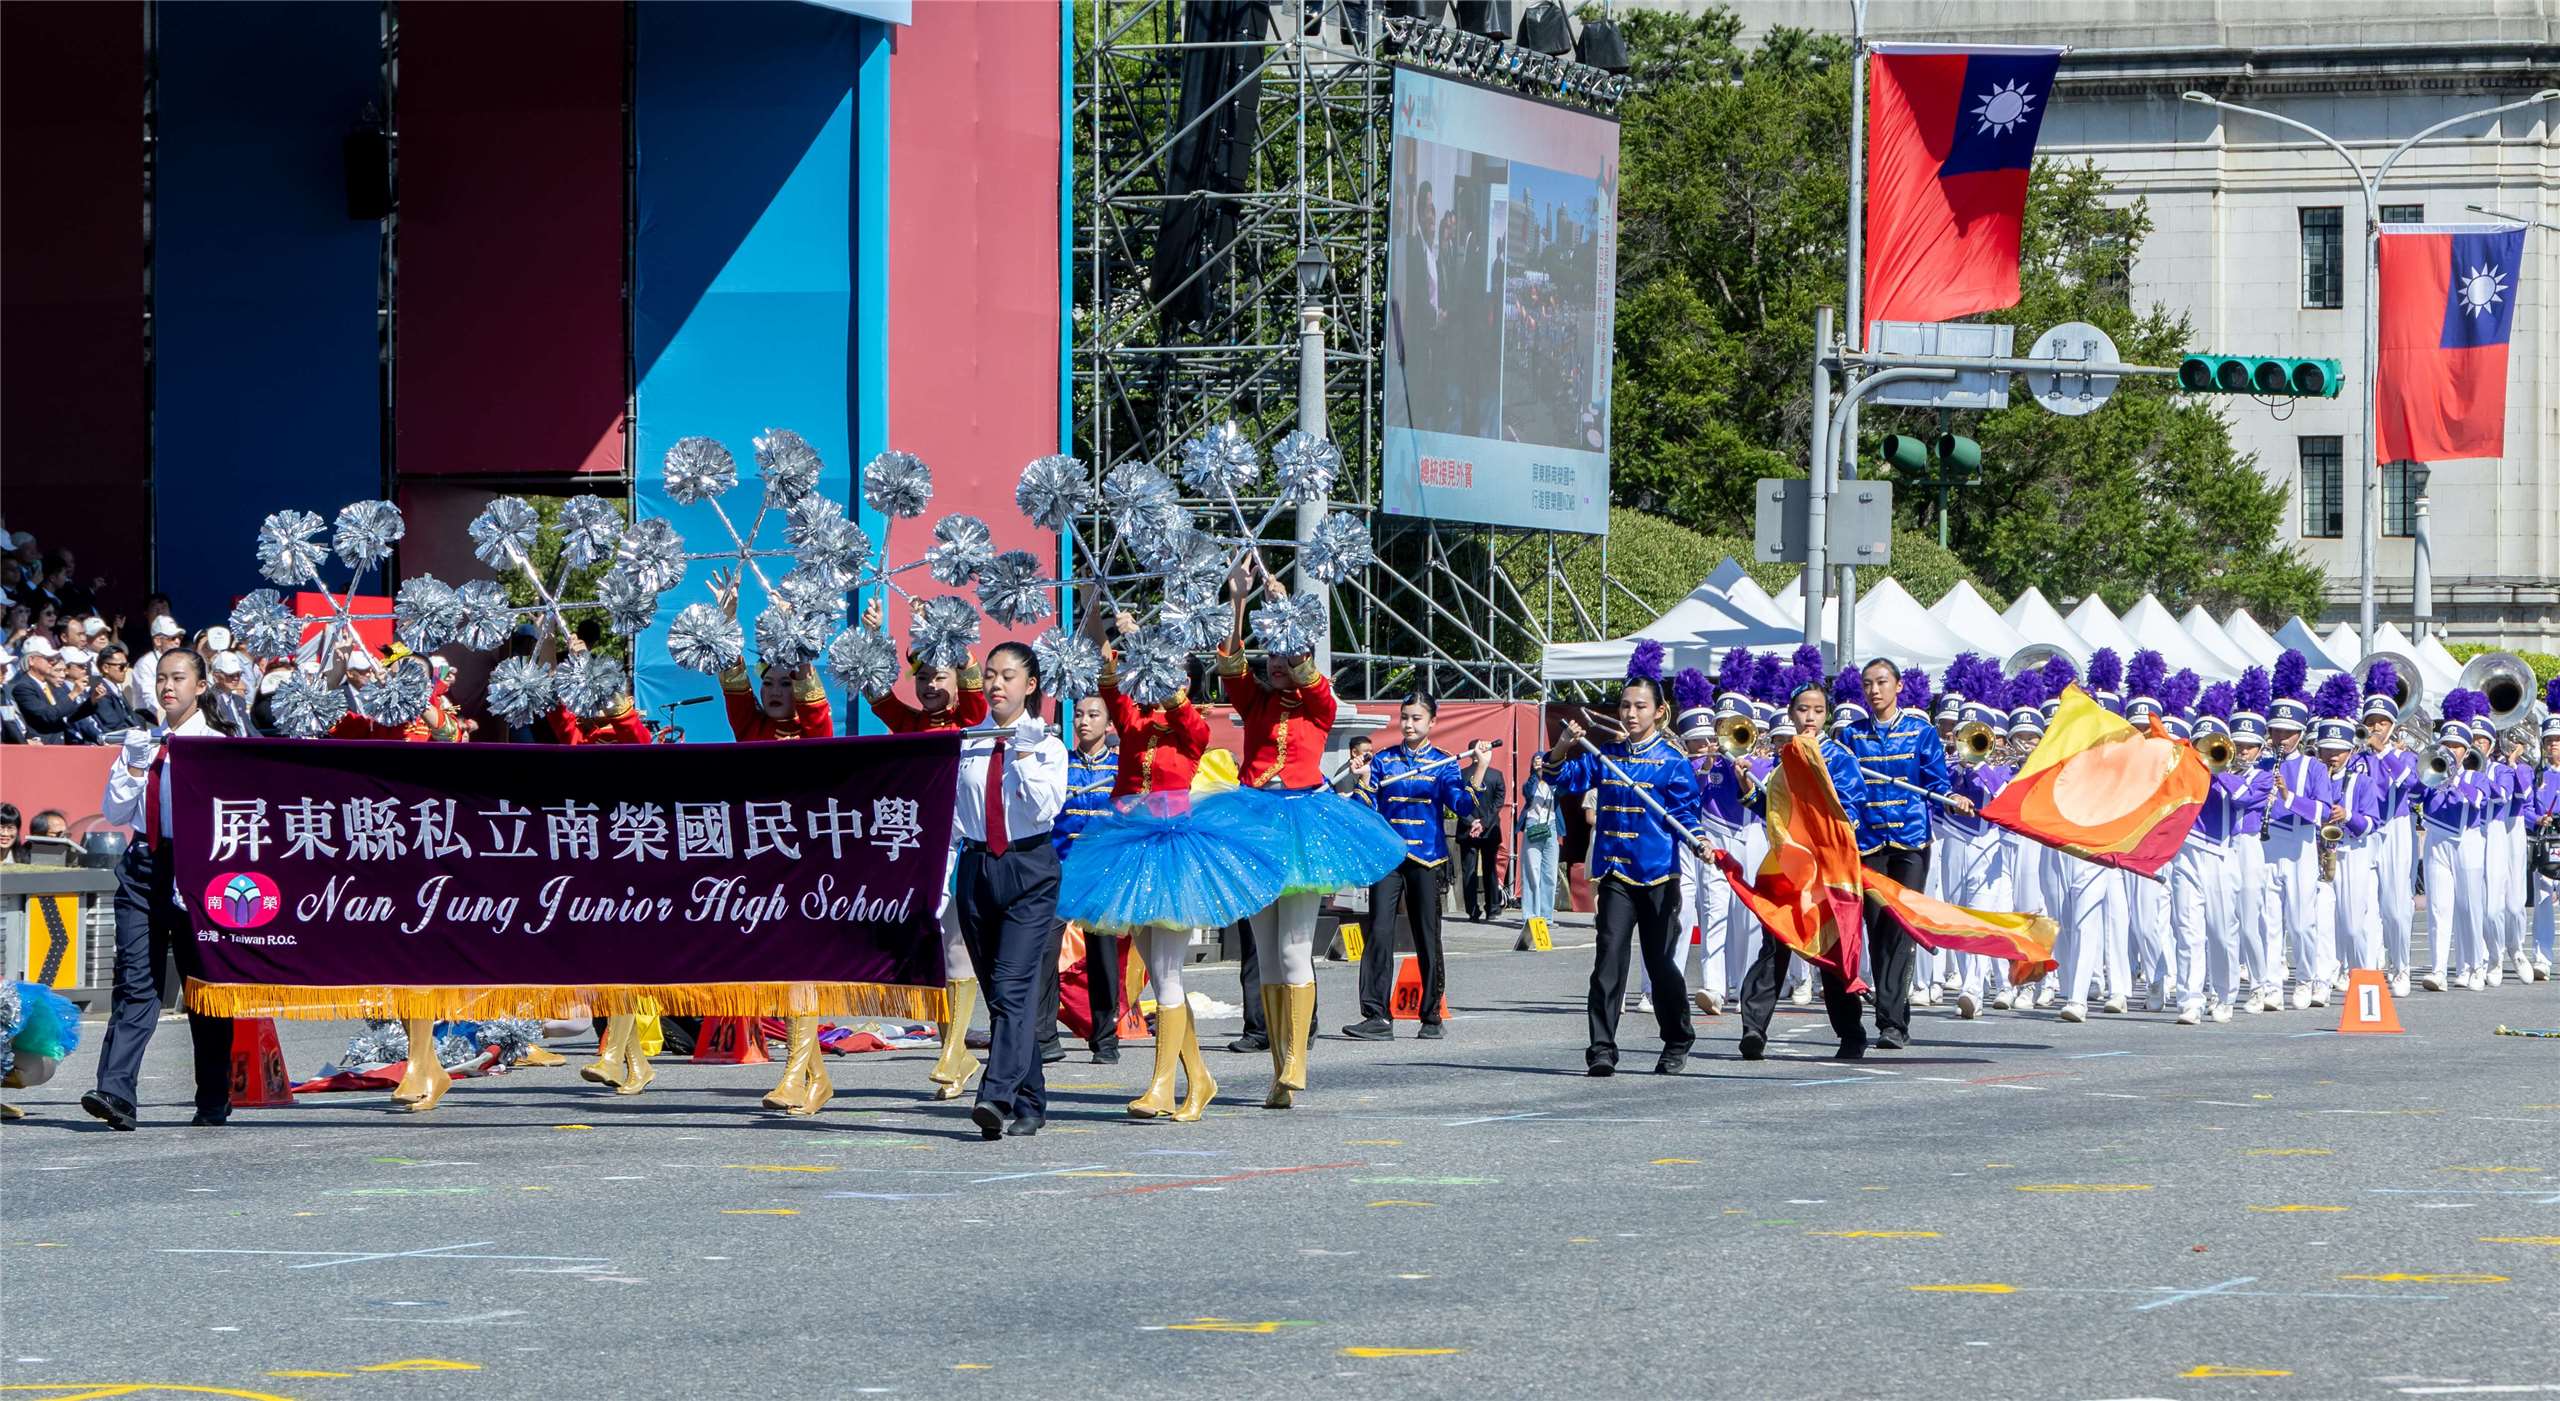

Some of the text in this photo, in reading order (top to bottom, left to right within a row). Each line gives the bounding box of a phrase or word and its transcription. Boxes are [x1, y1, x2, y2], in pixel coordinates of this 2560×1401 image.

[208, 795, 923, 862] 屏東縣私立南榮國民中學
[208, 896, 222, 910] 南
[263, 896, 277, 910] 榮
[295, 873, 914, 934] Nan Jung Junior High School
[197, 930, 297, 945] 台灣 Taiwan R.O.C.
[1348, 928, 1363, 956] 40
[1397, 987, 1419, 1011] 30
[2363, 990, 2377, 1016] 1
[710, 1024, 736, 1052] 40
